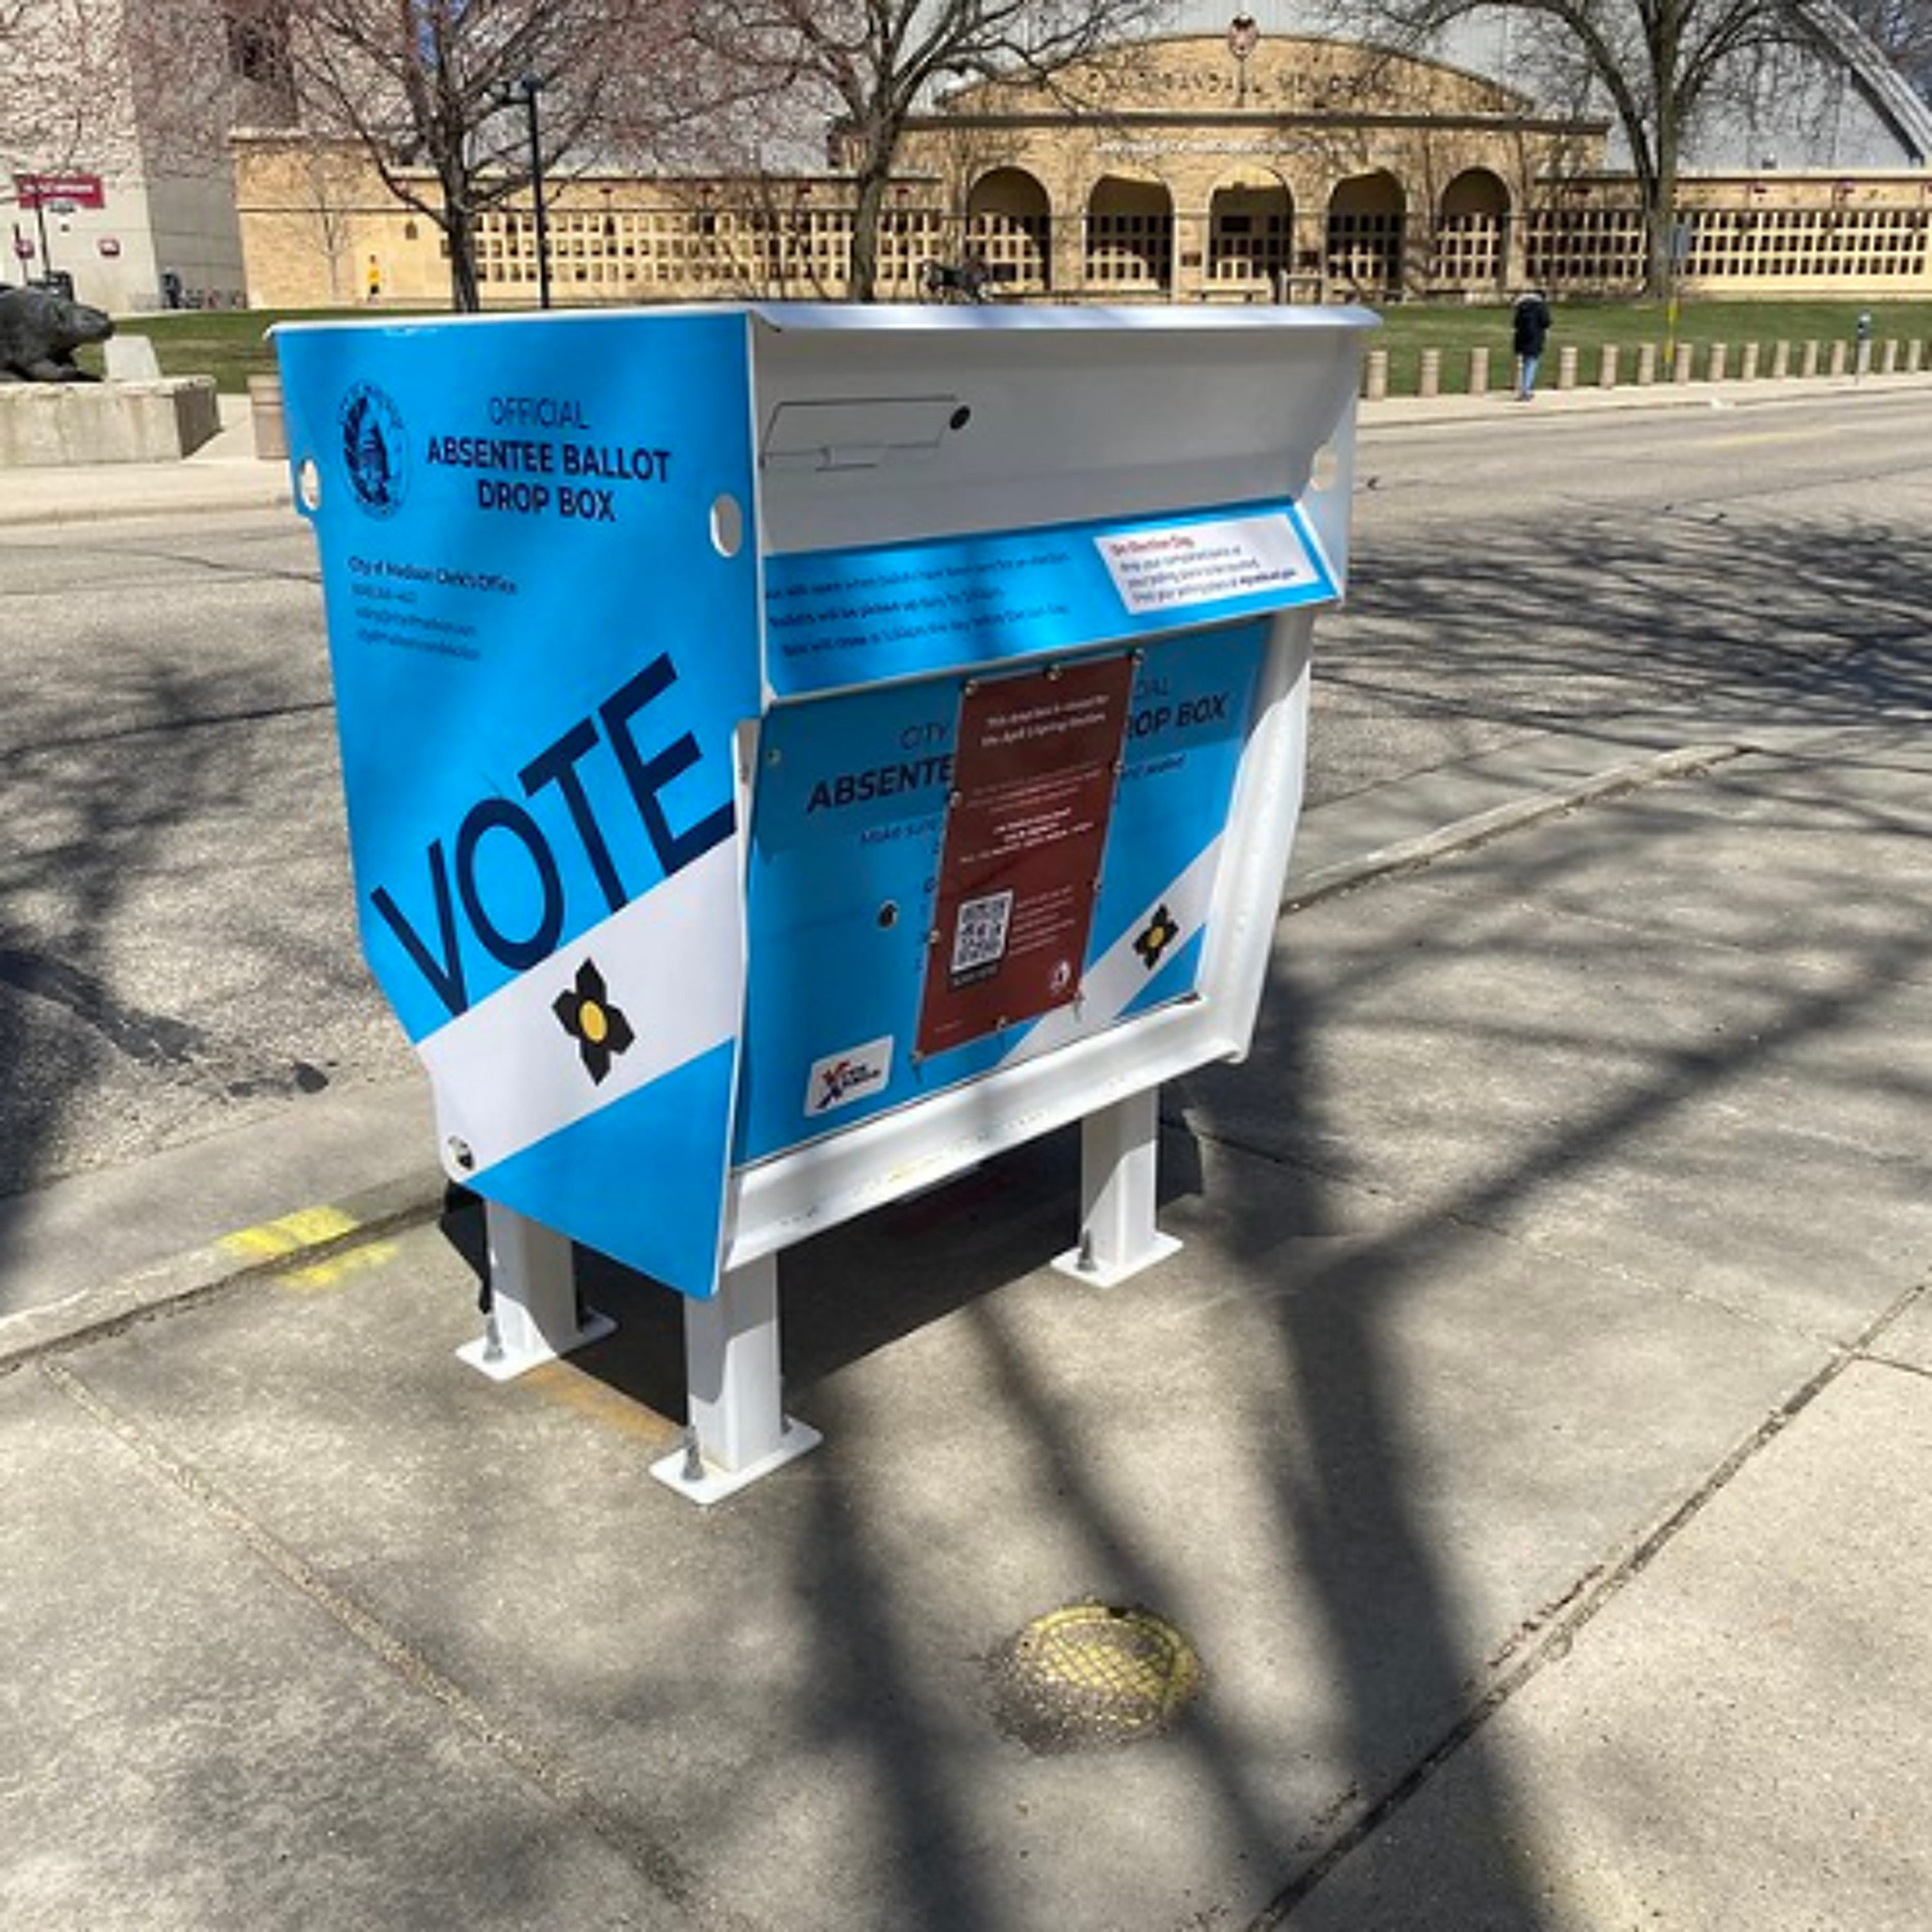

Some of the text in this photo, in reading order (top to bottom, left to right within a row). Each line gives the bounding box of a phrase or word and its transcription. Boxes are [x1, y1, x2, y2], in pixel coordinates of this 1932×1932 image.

[489, 397, 591, 430] OFFICIAL
[427, 435, 670, 483] ABSENTEE BALLOT
[477, 478, 616, 522] DROP BOX
[1127, 692, 1229, 741] OP BOX
[806, 753, 954, 814] ABSENTE
[370, 652, 737, 1017] VOTE
